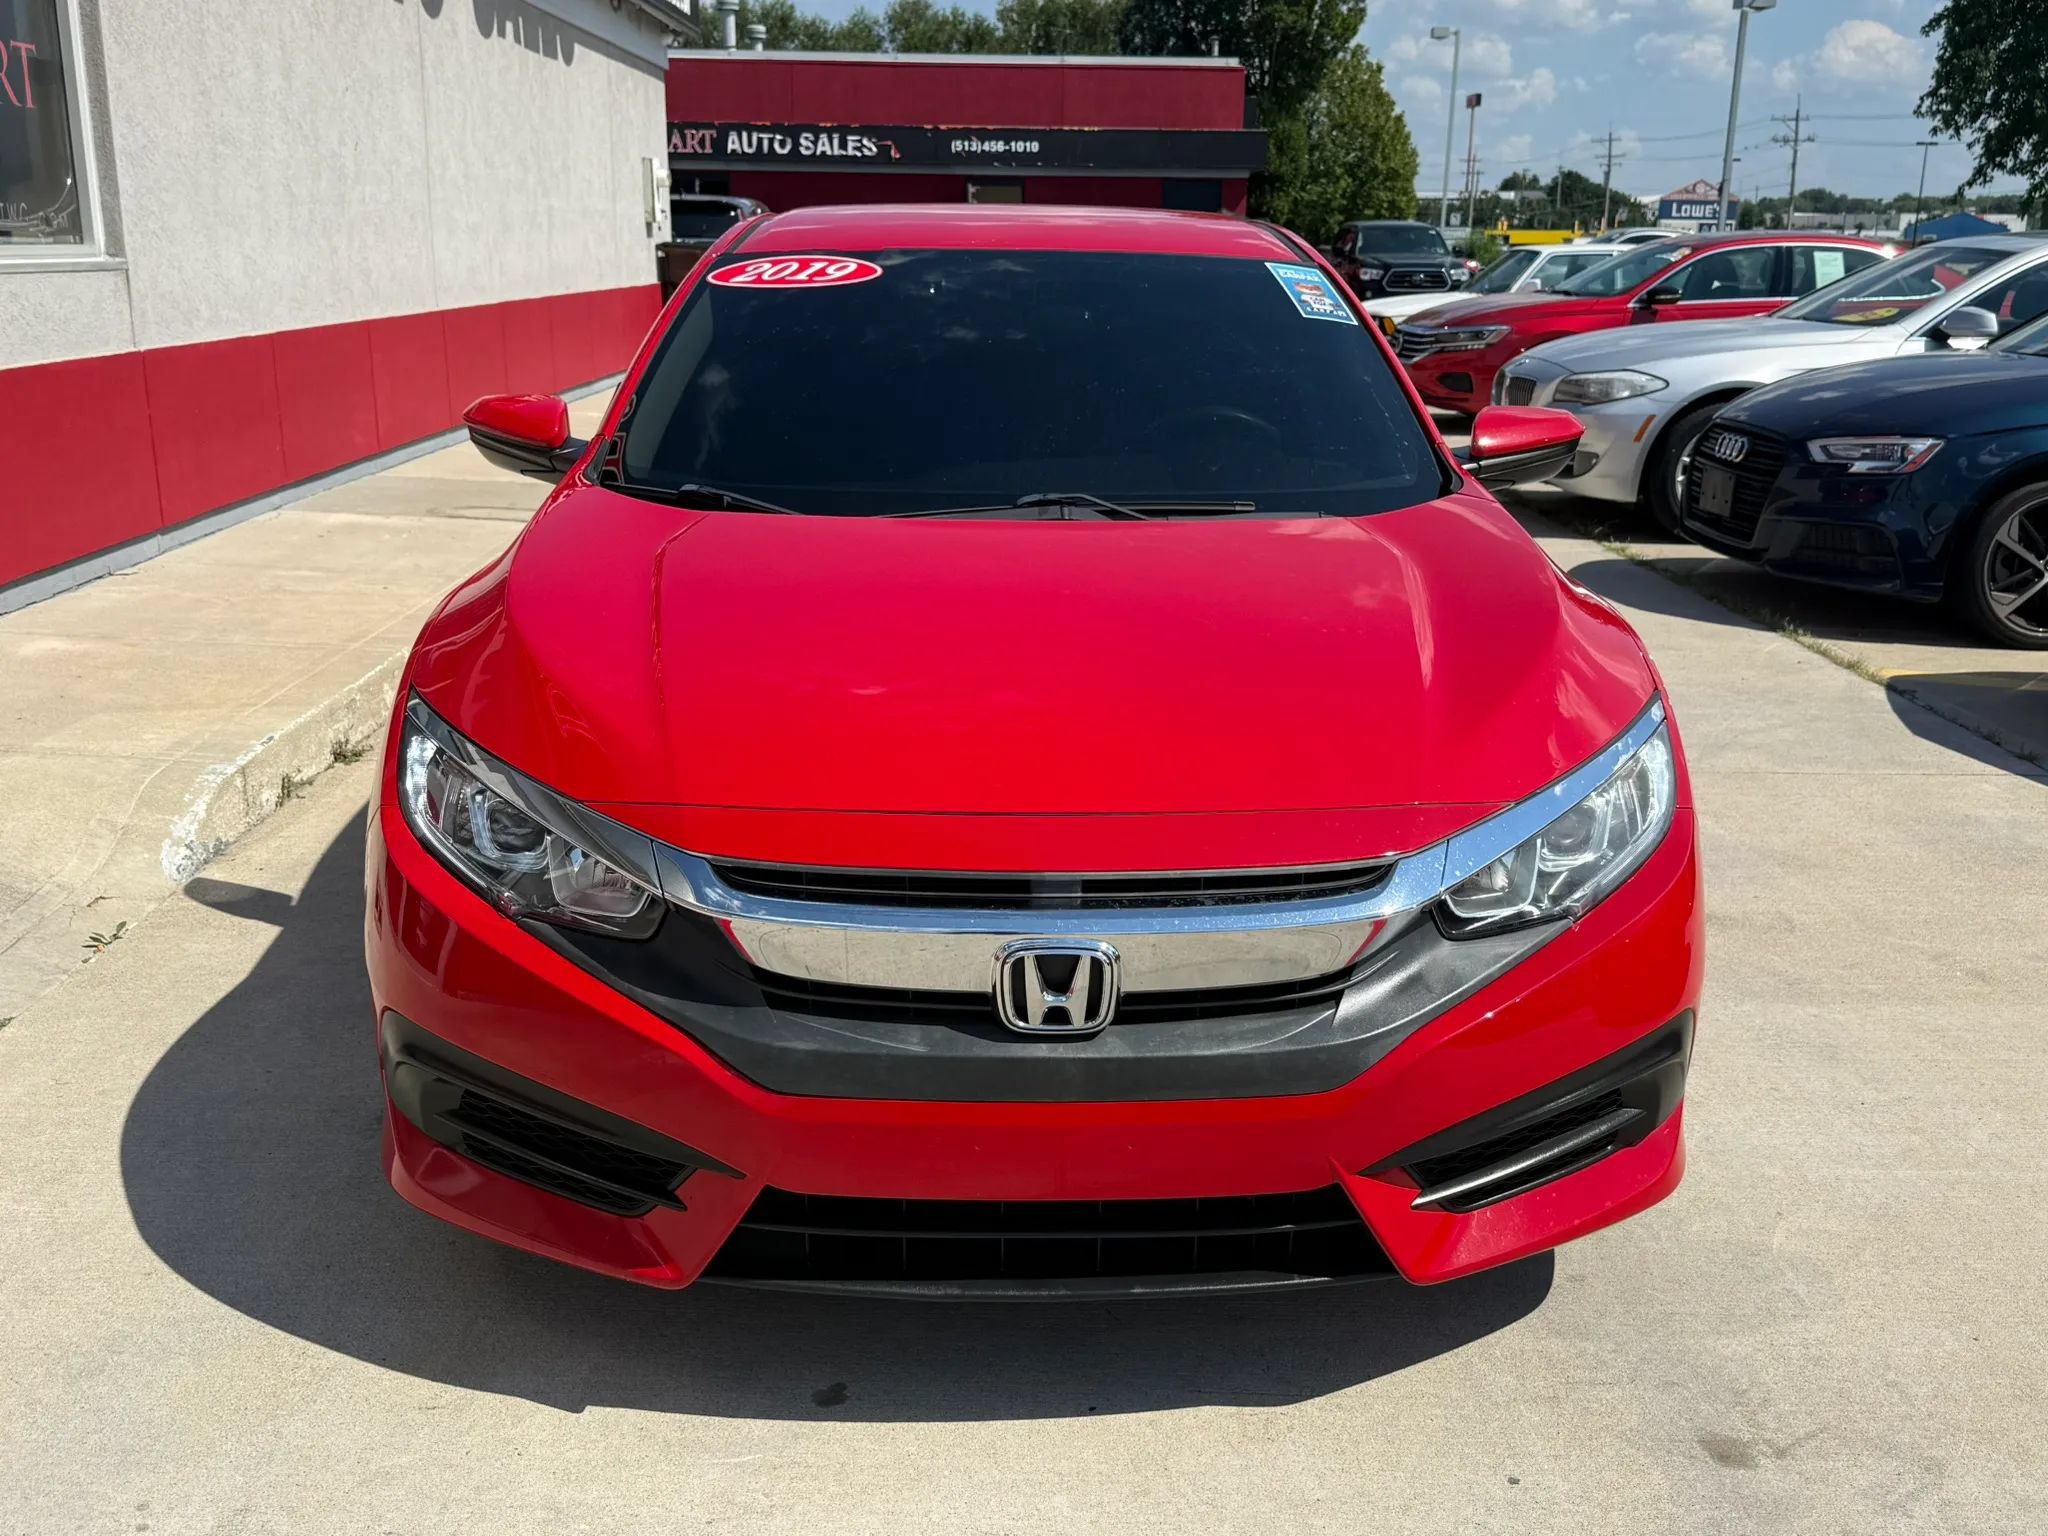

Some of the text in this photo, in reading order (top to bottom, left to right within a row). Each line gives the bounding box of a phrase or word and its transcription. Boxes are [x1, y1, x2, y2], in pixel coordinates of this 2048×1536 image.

[668, 129, 878, 157] ART AUTO SALES
[951, 140, 1040, 154] (513)456-1010
[729, 261, 858, 283] 2019
